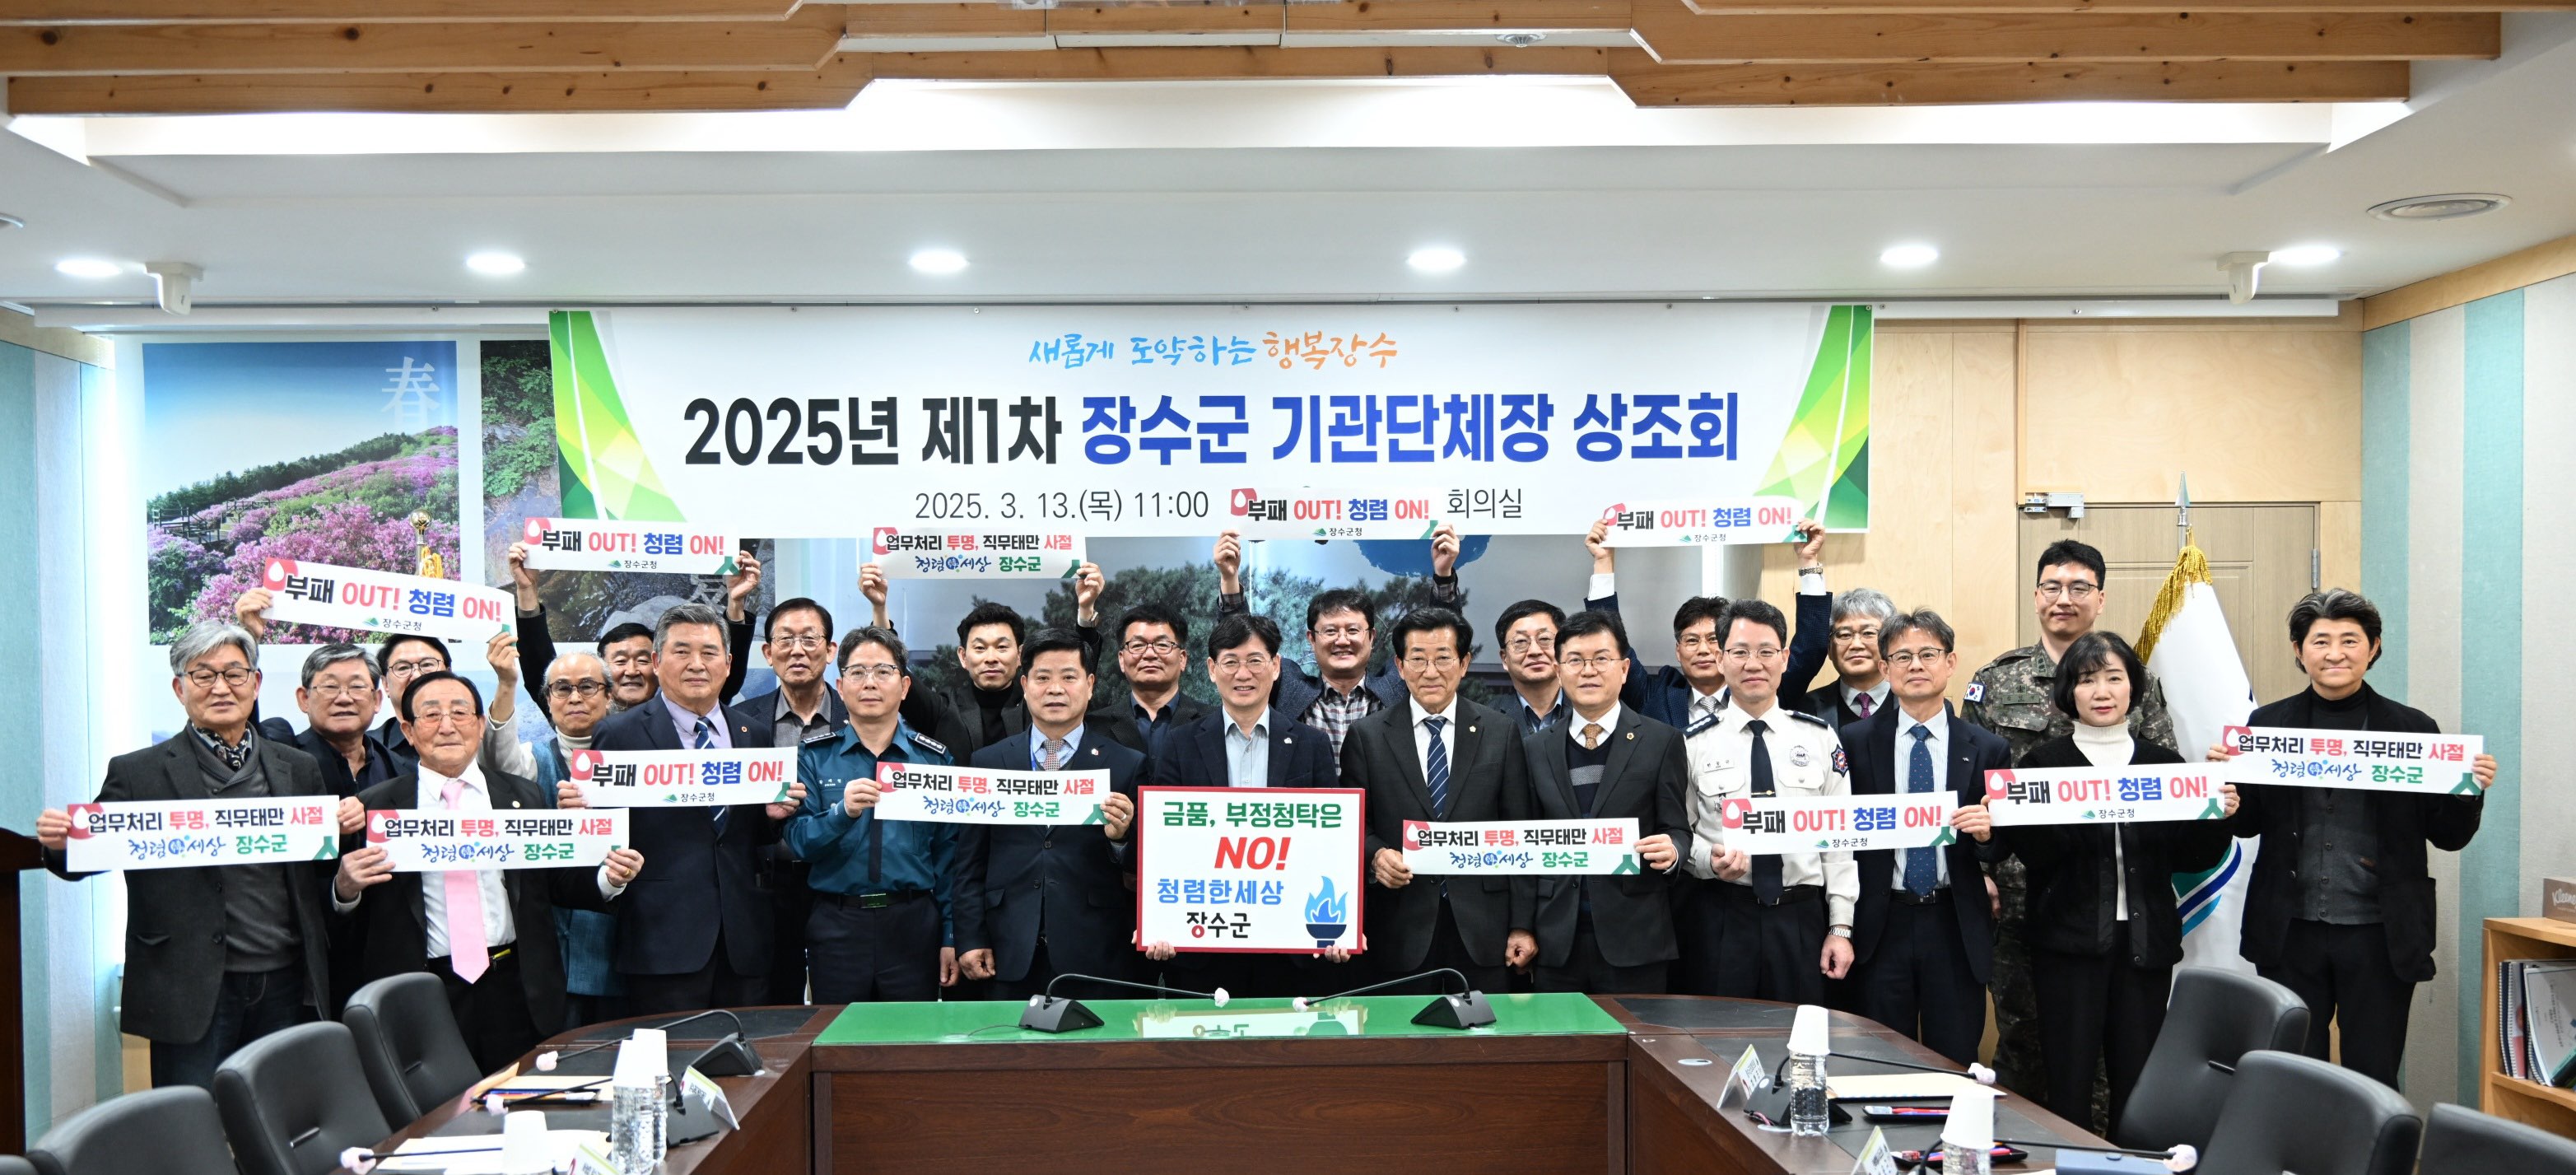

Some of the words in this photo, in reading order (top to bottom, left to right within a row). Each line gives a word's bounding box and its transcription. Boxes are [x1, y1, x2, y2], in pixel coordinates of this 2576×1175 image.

[1028, 333, 1115, 369] 새롭게
[1131, 335, 1256, 366] 도약하는
[1263, 330, 1399, 370] 행복장수
[683, 396, 899, 466] 2025년
[921, 395, 1062, 464] 제1차
[1082, 394, 1250, 466] 장수군
[1272, 393, 1554, 464] 기관단체장
[1573, 392, 1738, 463] 상조회
[915, 492, 990, 520] 2025.
[1000, 493, 1025, 520] 3.
[1134, 491, 1209, 519] 11:00
[1446, 488, 1523, 520] 회의실
[1247, 499, 1287, 521] 부패
[1293, 499, 1342, 520] OUT!
[1349, 499, 1388, 521] 청렴
[1394, 499, 1429, 520] ON!
[1616, 511, 1654, 531] 부패
[1661, 510, 1706, 528] OUT!
[1713, 507, 1751, 528] 청렴
[1758, 506, 1791, 526] ON!
[542, 529, 581, 552] 부패
[589, 532, 636, 553] OUT!
[644, 533, 683, 555] 청렴
[690, 535, 724, 556] ON!
[886, 534, 943, 551] 업무처리
[947, 534, 979, 551] 투명,
[983, 534, 1039, 550] 직무태만
[1044, 534, 1072, 550] 사절
[1329, 527, 1363, 537] 장수군청
[1694, 534, 1726, 543] 장수군청
[624, 559, 657, 570] 장수군청
[999, 556, 1041, 572] 장수군
[285, 575, 334, 604] 부패
[342, 581, 400, 610] OUT!
[408, 588, 455, 618] 청렴
[463, 597, 501, 622] ON!
[382, 618, 422, 632] 장수군청
[2238, 734, 2303, 755] 업무처리
[2309, 738, 2348, 757] 투명,
[2353, 739, 2423, 760] 직무태만
[2428, 743, 2464, 762] 사절
[592, 763, 636, 786] 부패
[644, 762, 694, 786] OUT!
[701, 761, 742, 785] 청렴
[748, 761, 784, 782] ON!
[892, 771, 953, 791] 업무처리
[957, 776, 991, 795] 투명,
[996, 779, 1059, 796] 직무태만
[1063, 778, 1095, 795] 사절
[2371, 765, 2424, 785] 장수군
[681, 792, 715, 803] 장수군청
[2007, 781, 2051, 804] 부패
[2058, 779, 2111, 802] OUT!
[2117, 776, 2162, 802] 청렴
[2170, 776, 2207, 798] ON!
[89, 812, 163, 832] 업무처리
[169, 810, 209, 831] 투명,
[215, 808, 284, 829] 직무태만
[291, 806, 324, 824] 사절
[1013, 800, 1060, 818] 장수군
[1162, 801, 1215, 828] 금품,
[1226, 802, 1342, 828] 부정청탁은
[1742, 810, 1786, 834] 부패
[1793, 809, 1846, 832] OUT!
[1853, 807, 1897, 832] 청렴
[1904, 805, 1941, 828] ON!
[2099, 809, 2135, 819] 장수군청
[385, 819, 454, 837] 업무처리
[460, 819, 500, 838] 투명,
[505, 818, 574, 837] 직무태만
[579, 818, 613, 836] 사절
[1418, 830, 1479, 847] 업무처리
[1484, 829, 1520, 846] 투명,
[1523, 828, 1586, 846] 직무태만
[1591, 828, 1623, 845] 사절
[235, 834, 287, 854] 장수군
[524, 842, 575, 860] 장수군
[1832, 837, 1868, 847] 장수군청
[1213, 837, 1292, 870] NO!
[1542, 851, 1588, 869] 장수군
[1157, 879, 1283, 905] 청렴한세상
[1186, 912, 1251, 939] 장수군
